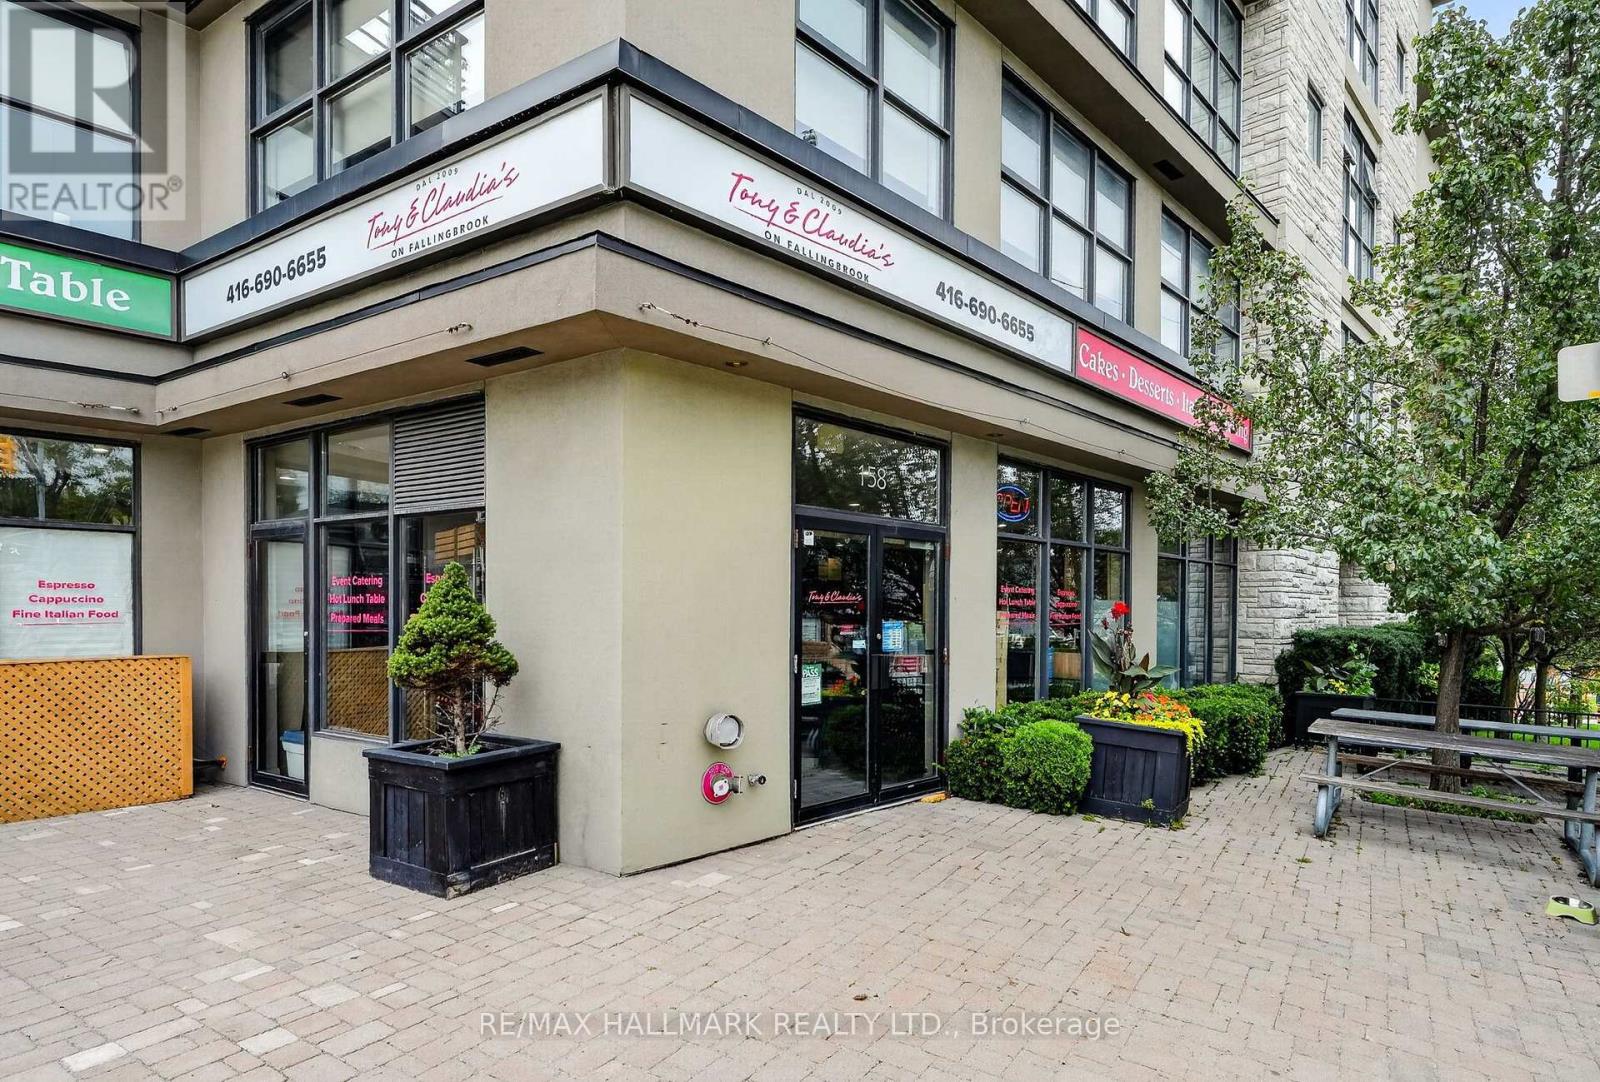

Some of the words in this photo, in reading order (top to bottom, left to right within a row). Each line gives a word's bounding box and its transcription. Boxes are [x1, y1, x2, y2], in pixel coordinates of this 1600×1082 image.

[416, 178, 432, 191] DAL
[436, 167, 459, 180] 2009
[367, 211, 403, 249] Tony
[406, 197, 419, 229] &
[421, 162, 520, 223] Claudia's
[797, 187, 815, 200] DAL
[820, 196, 843, 215] 2009
[728, 172, 780, 228] Tony
[783, 201, 800, 224] &
[802, 207, 895, 267] Claudia's
[391, 247, 404, 259] ON
[409, 215, 489, 253] FALLINGBROOK
[764, 230, 781, 244] ON
[787, 240, 870, 283] FALLINGBROOK
[0, 255, 131, 312] Table
[226, 245, 326, 304] 416-690-6655
[935, 281, 1034, 342] 416-690-6655
[1079, 343, 1119, 382] Cakes
[1129, 366, 1175, 407] Desserts
[859, 464, 887, 489] 158
[37, 580, 96, 590] Espresso
[332, 575, 351, 586] Event
[352, 575, 383, 588] Catering
[28, 594, 105, 605] Cappuccino
[329, 593, 342, 604] Hot
[343, 593, 364, 604] Lunch
[366, 593, 385, 604] Table
[12, 609, 41, 619] Fine
[44, 610, 85, 619] Italian
[88, 610, 119, 619] Food
[330, 612, 362, 624] Prepared
[362, 613, 384, 624] Meals
[802, 668, 819, 678] PASS
